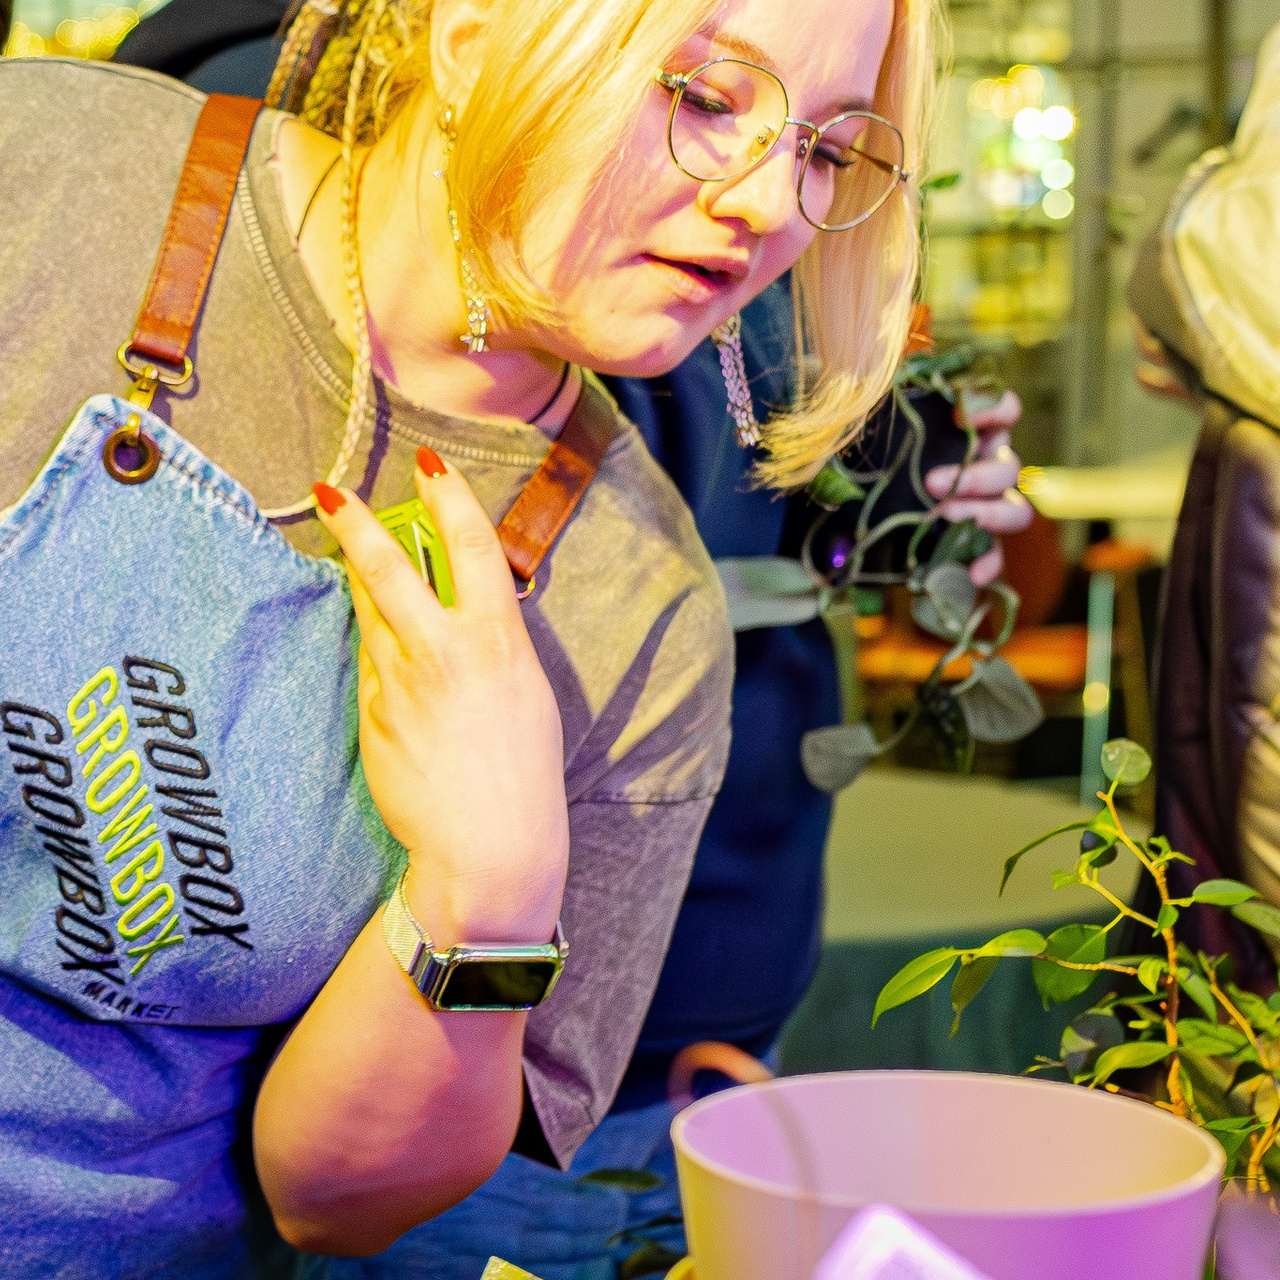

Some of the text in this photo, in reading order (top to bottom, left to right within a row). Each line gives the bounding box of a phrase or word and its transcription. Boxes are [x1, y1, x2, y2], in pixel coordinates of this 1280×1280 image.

[0, 700, 125, 985] GROWBOX
[67, 665, 184, 976] GROWBOX
[123, 655, 254, 950] GROWBOX
[80, 980, 182, 1020] MARKET
